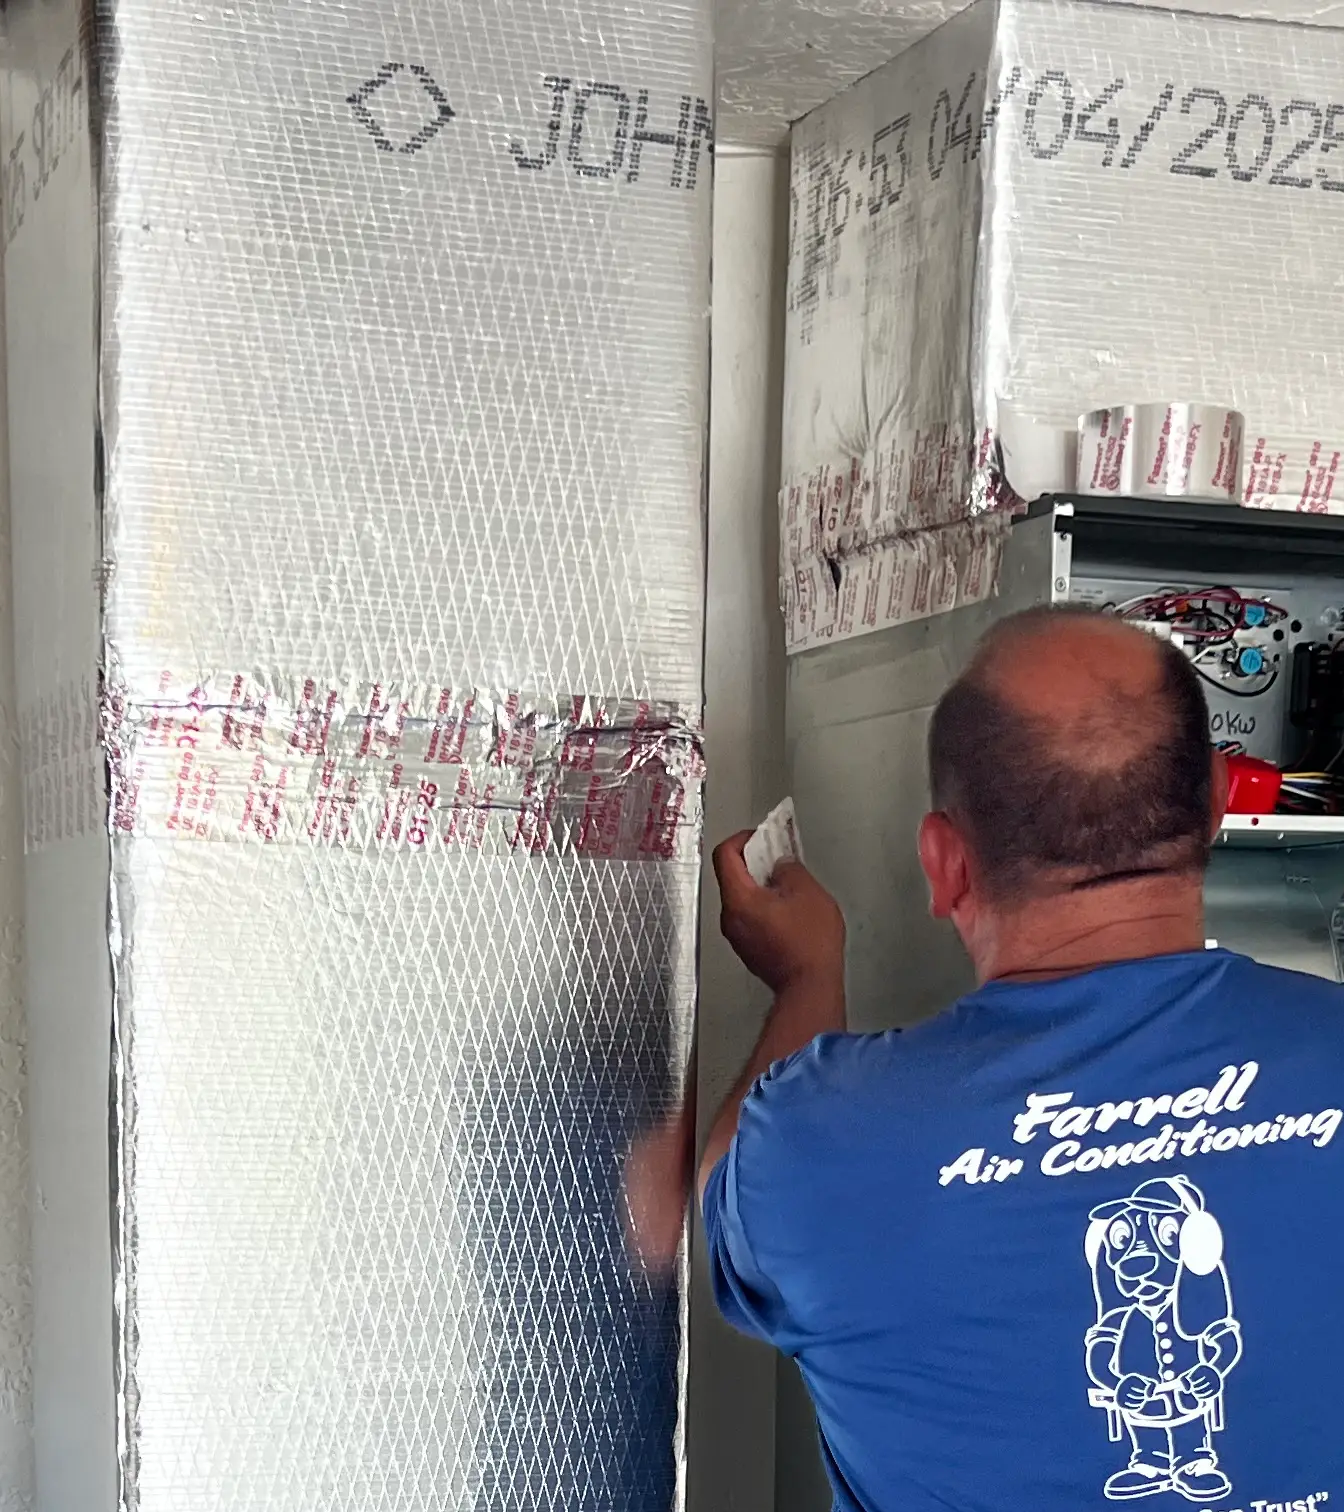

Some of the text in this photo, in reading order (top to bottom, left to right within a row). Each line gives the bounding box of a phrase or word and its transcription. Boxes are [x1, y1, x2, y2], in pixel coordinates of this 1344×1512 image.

[1013, 1060, 1259, 1145] Farrell
[937, 1107, 1344, 1186] Air Conditioning
